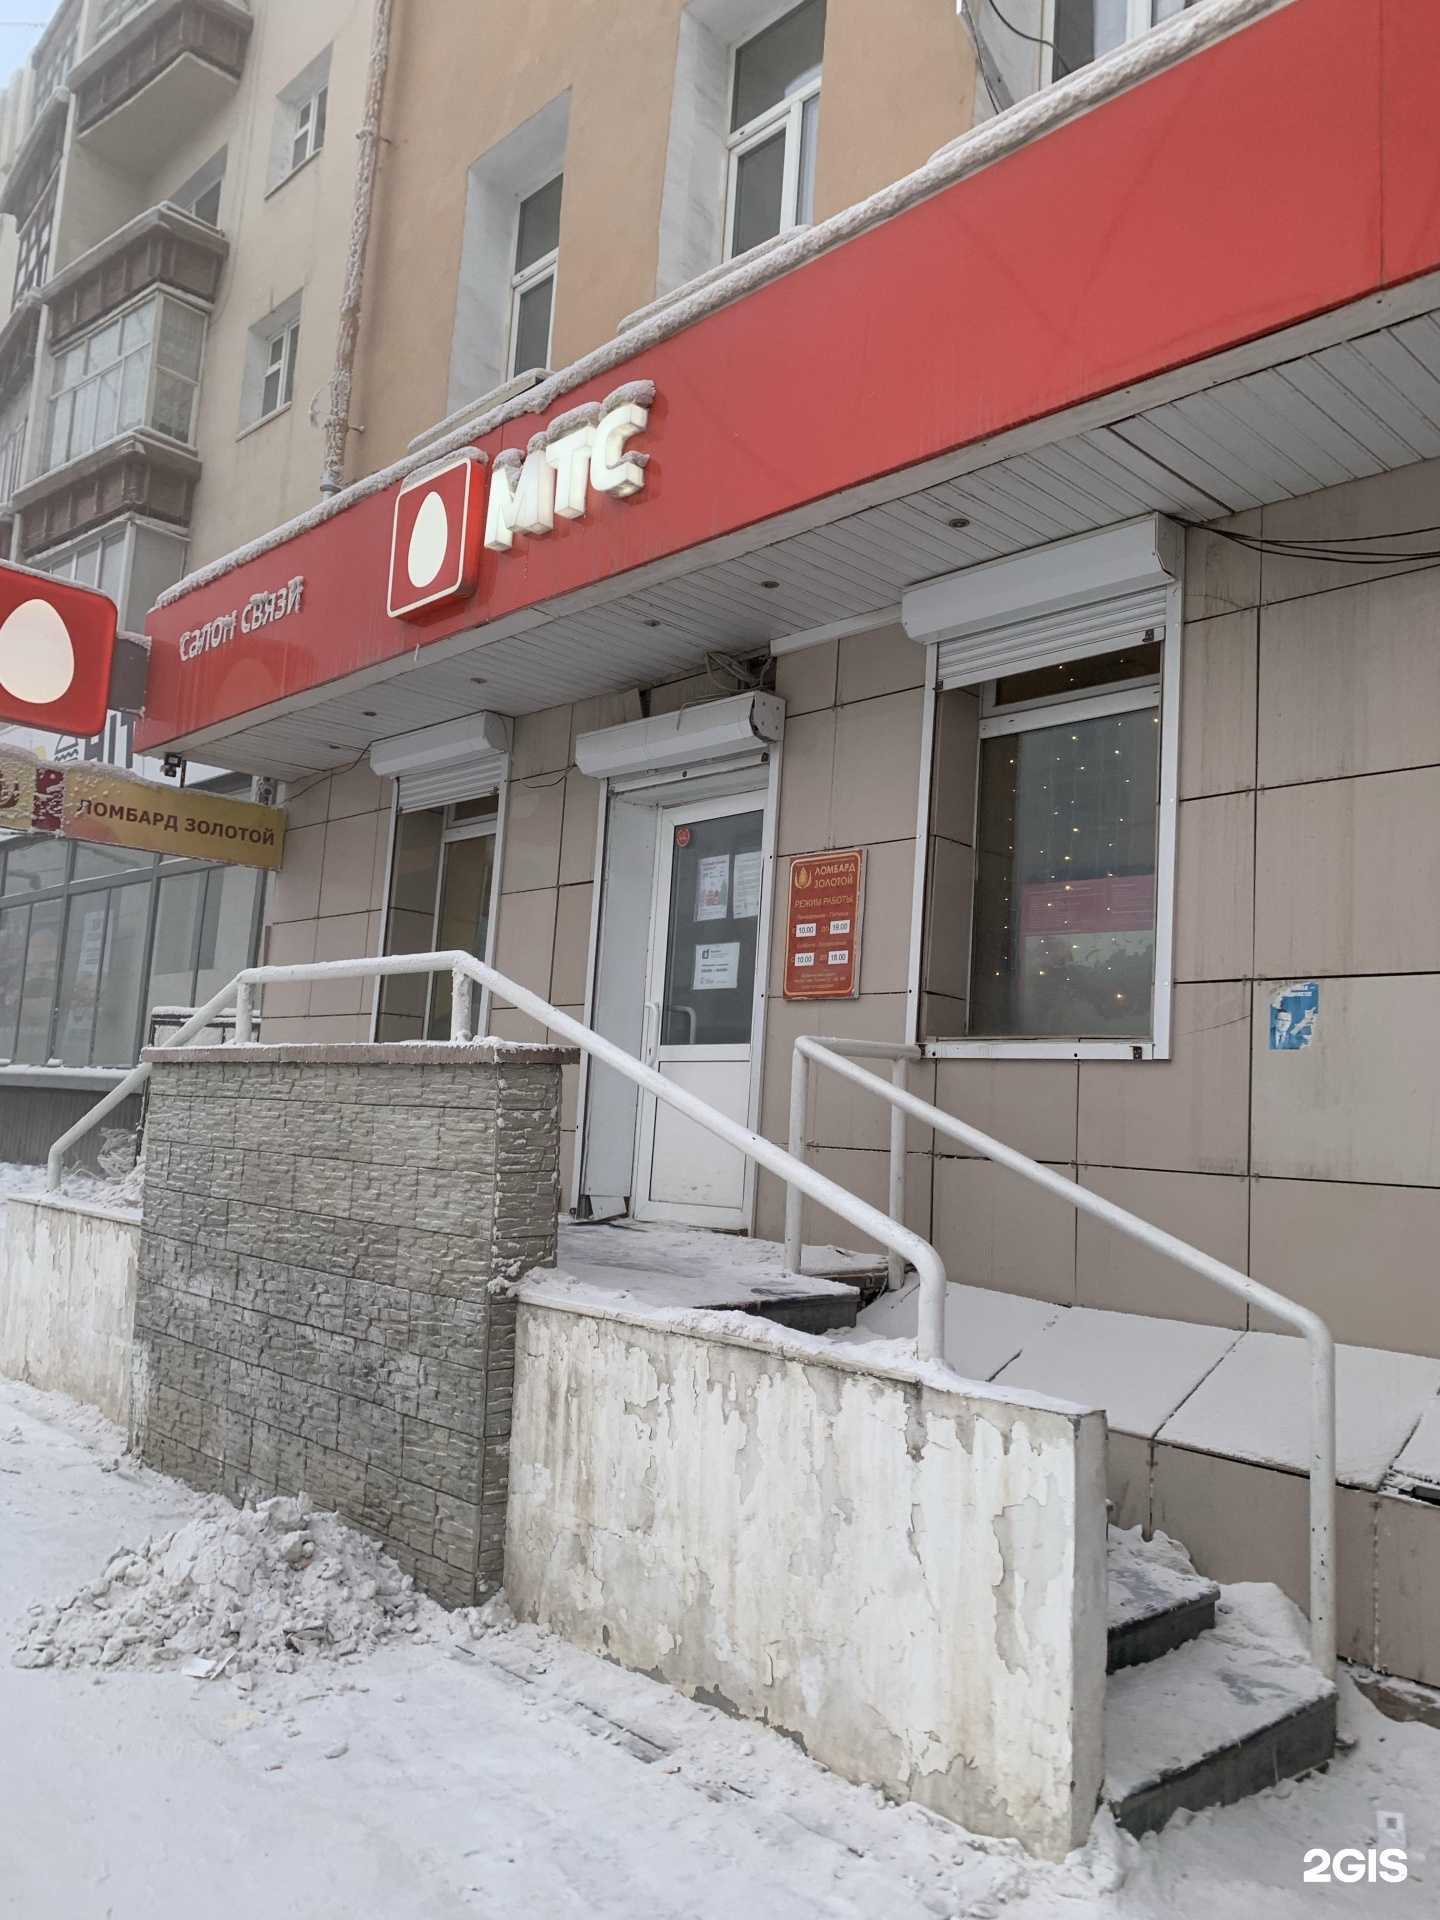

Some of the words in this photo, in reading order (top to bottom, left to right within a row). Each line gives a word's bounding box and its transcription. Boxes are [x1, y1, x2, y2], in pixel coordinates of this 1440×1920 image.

[484, 392, 651, 551] МТС
[77, 799, 179, 833] ЛОМБАРД
[184, 817, 275, 846] ЗОЛОТОЙ
[814, 863, 856, 876] ЛОМБАРД
[814, 873, 854, 889] ЗОЛОТОЙ
